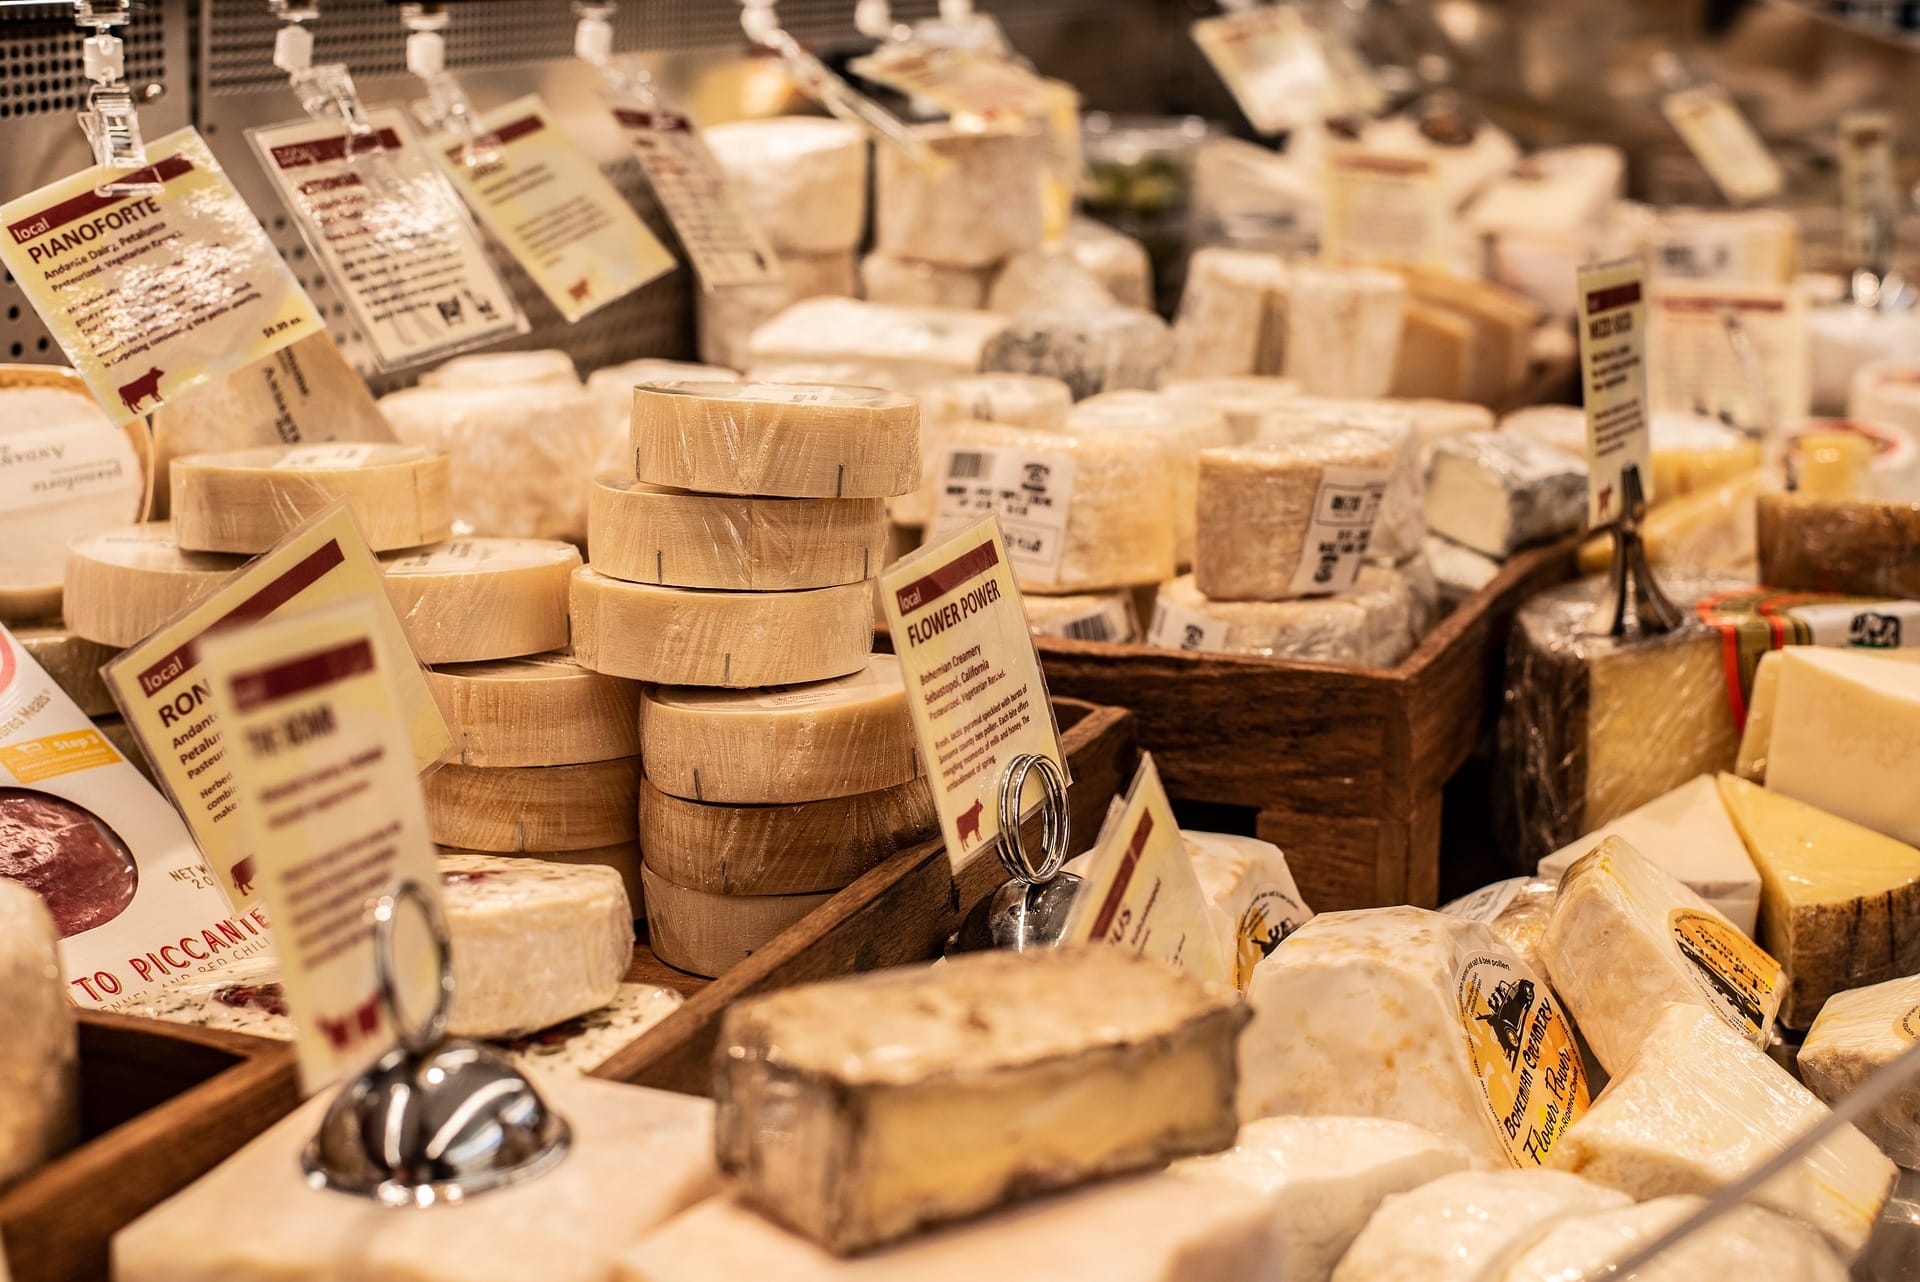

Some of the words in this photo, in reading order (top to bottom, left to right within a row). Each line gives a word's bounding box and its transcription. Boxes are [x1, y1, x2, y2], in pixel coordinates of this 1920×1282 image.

[14, 217, 50, 241] local
[27, 196, 161, 264] PIANOFORTE
[899, 587, 922, 611] local
[907, 602, 962, 648] FLOWER
[960, 579, 1001, 619] POWER
[143, 656, 183, 691] local
[919, 661, 952, 686] Bohemian
[952, 643, 981, 667] Creamery
[924, 675, 961, 706] Sebastopol,
[961, 660, 990, 684] California
[961, 680, 988, 702] Vegetarian
[963, 713, 982, 735] pyramid
[982, 702, 1001, 721] speckled
[1001, 696, 1011, 708] with
[1010, 689, 1024, 702] bursts
[998, 713, 1009, 726] Each
[1008, 708, 1018, 719] bite
[1017, 700, 1029, 713] offers
[1000, 729, 1008, 741] and
[1021, 715, 1030, 725] The
[187, 746, 227, 780] Pasteur
[981, 755, 997, 769] spring.
[212, 802, 237, 823] make
[169, 867, 197, 882] NET
[70, 971, 122, 1001] TO
[129, 906, 272, 982] PICCANTE
[1491, 959, 1511, 971] pollen.
[1504, 1067, 1533, 1140] BOHEMIAN
[1522, 997, 1553, 1069] CREAMERY
[1522, 1100, 1559, 1166] Flower
[1545, 1048, 1571, 1101] Power
